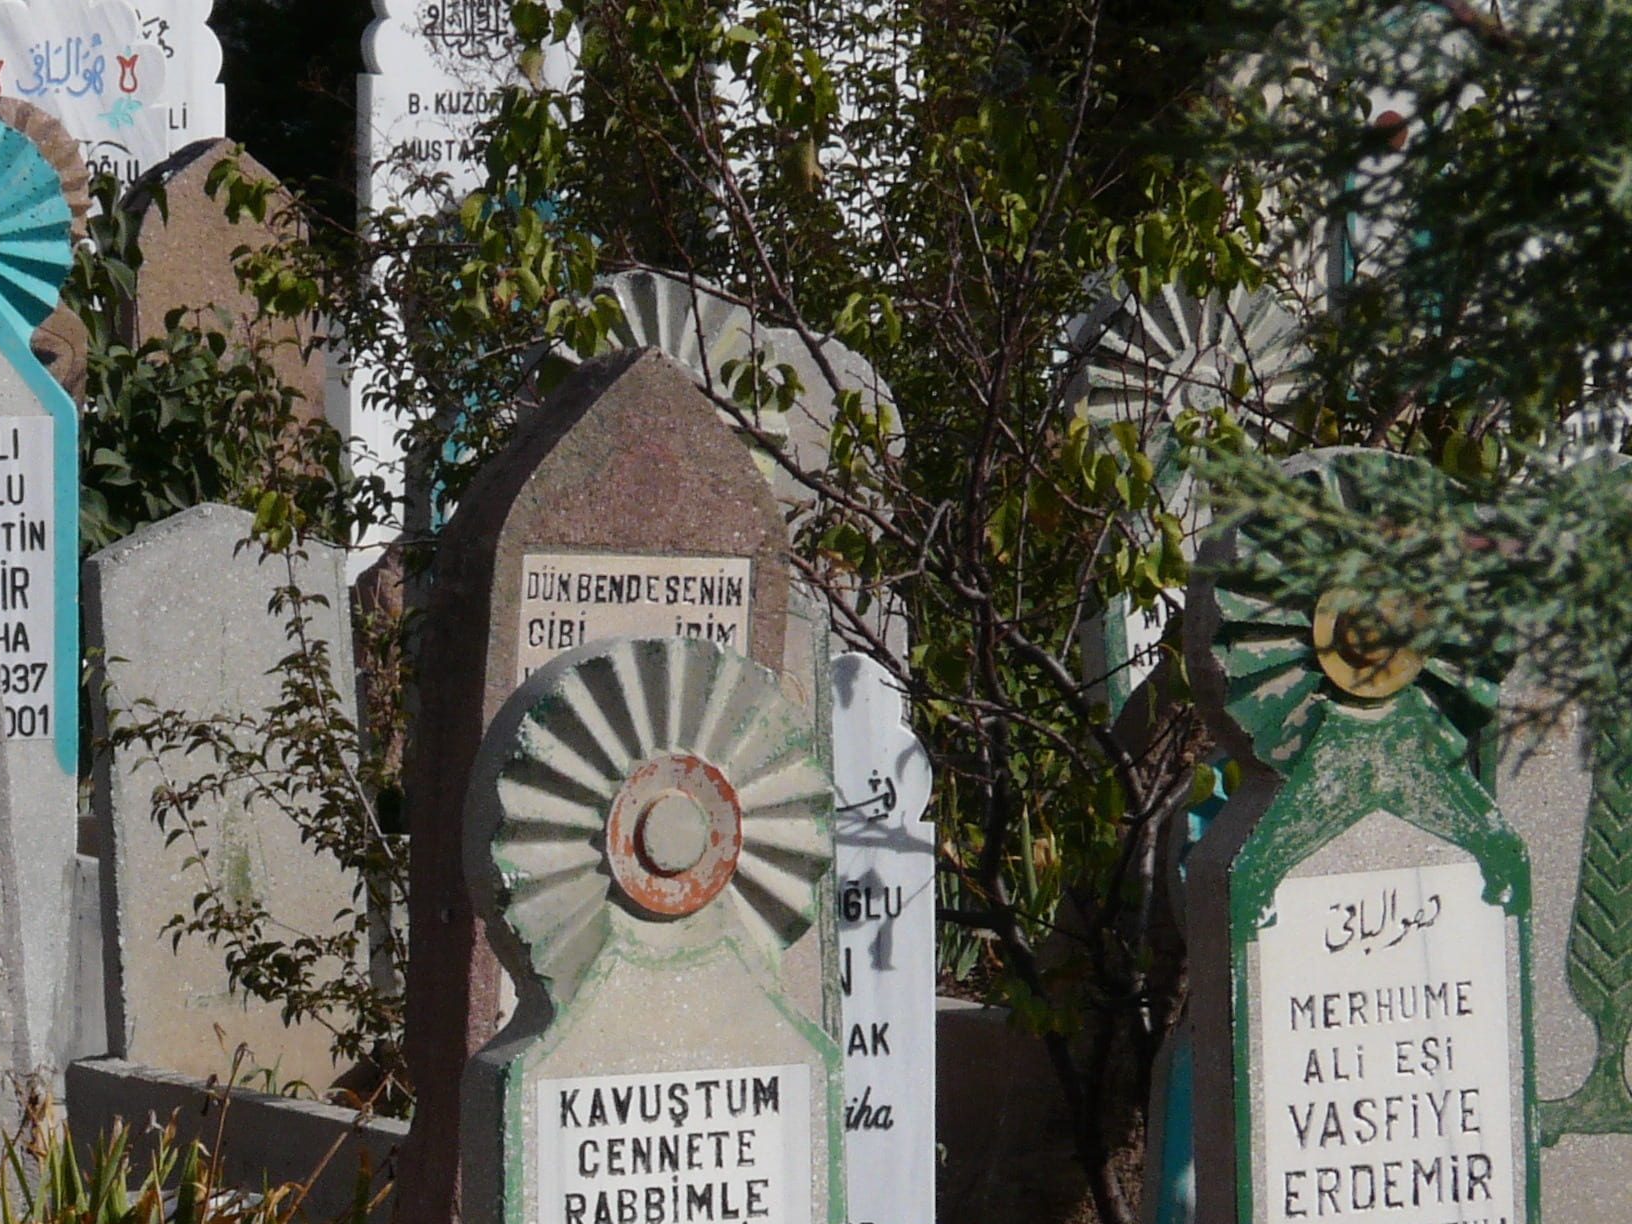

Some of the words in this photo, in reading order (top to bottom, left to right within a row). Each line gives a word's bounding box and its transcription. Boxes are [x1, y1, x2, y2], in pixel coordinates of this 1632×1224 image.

[1291, 981, 1474, 1031] MERHUME
[1304, 1047, 1364, 1085] ALİ
[1396, 1037, 1454, 1078] EŞİ
[560, 1076, 781, 1129] KAVUŞTUM
[1289, 1089, 1481, 1150] VASFİYE
[578, 1129, 757, 1178] CENNETE
[1284, 1154, 1495, 1218] ERDEMİR
